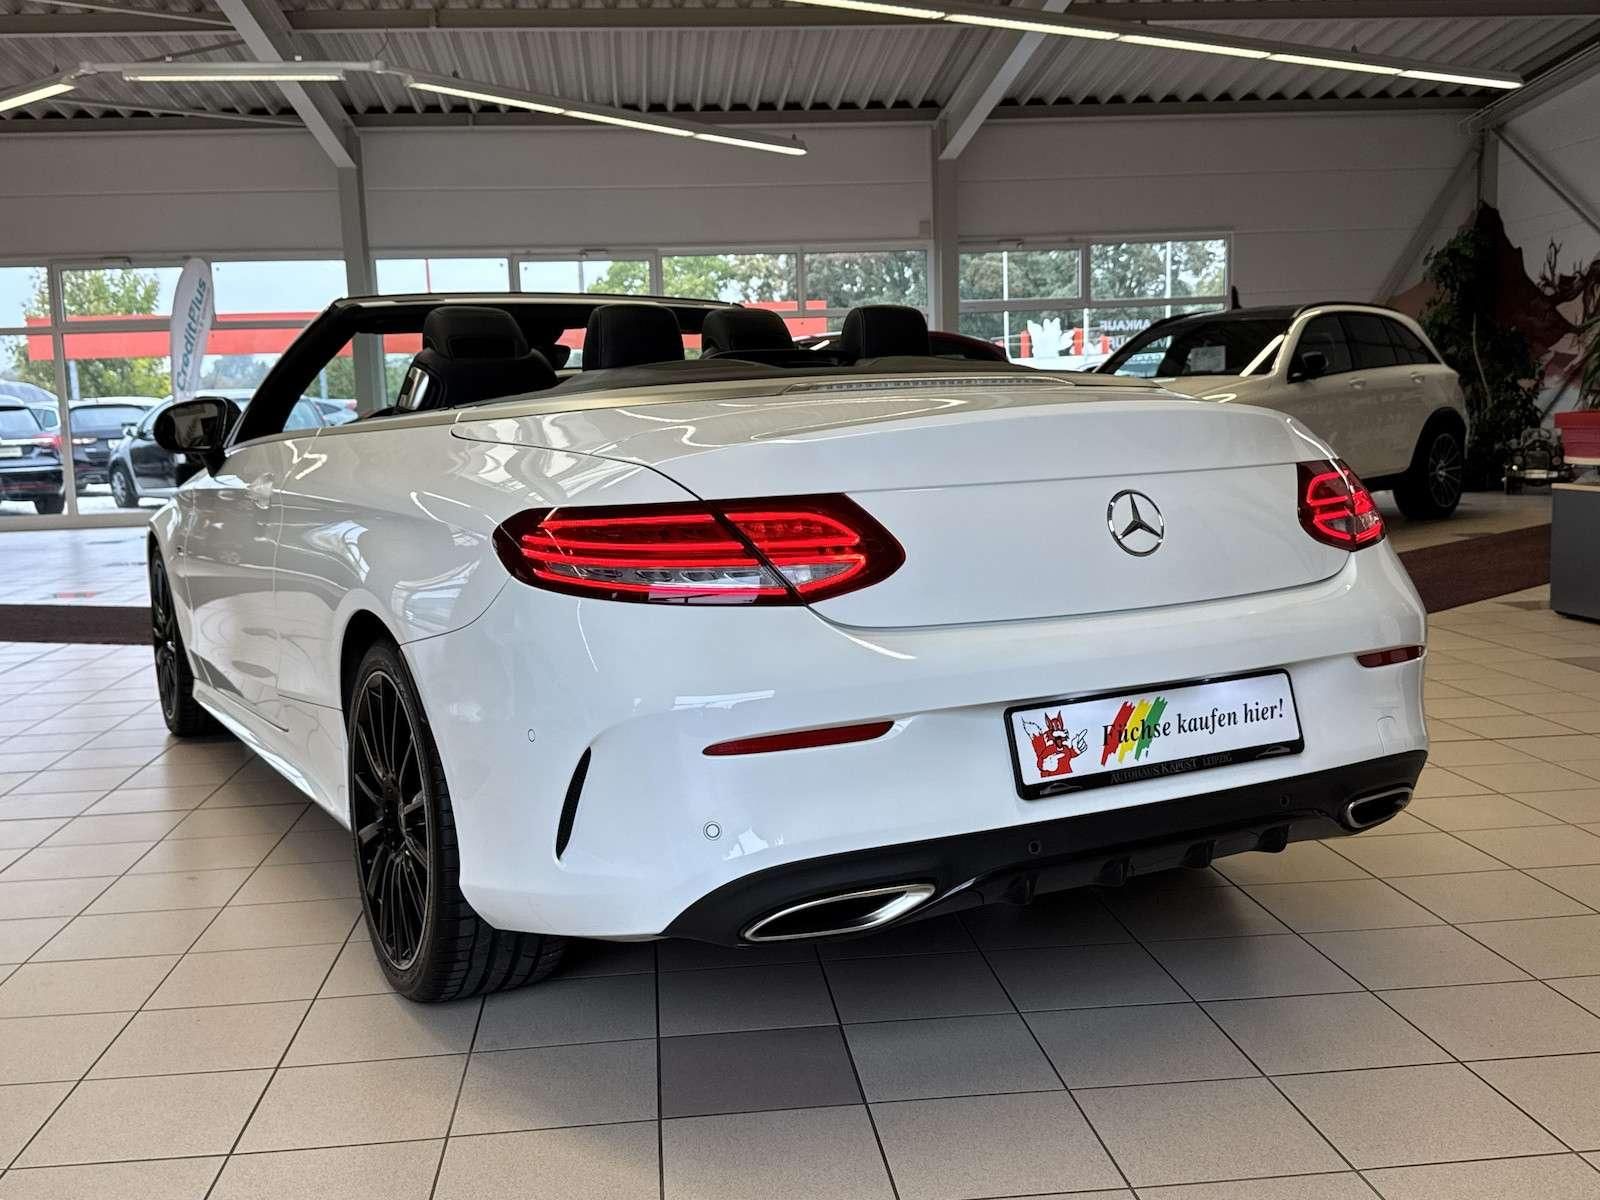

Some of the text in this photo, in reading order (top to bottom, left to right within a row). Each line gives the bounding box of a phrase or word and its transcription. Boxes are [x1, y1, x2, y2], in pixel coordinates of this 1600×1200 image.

[1102, 698, 1283, 747] Füchse kaufen hier!
